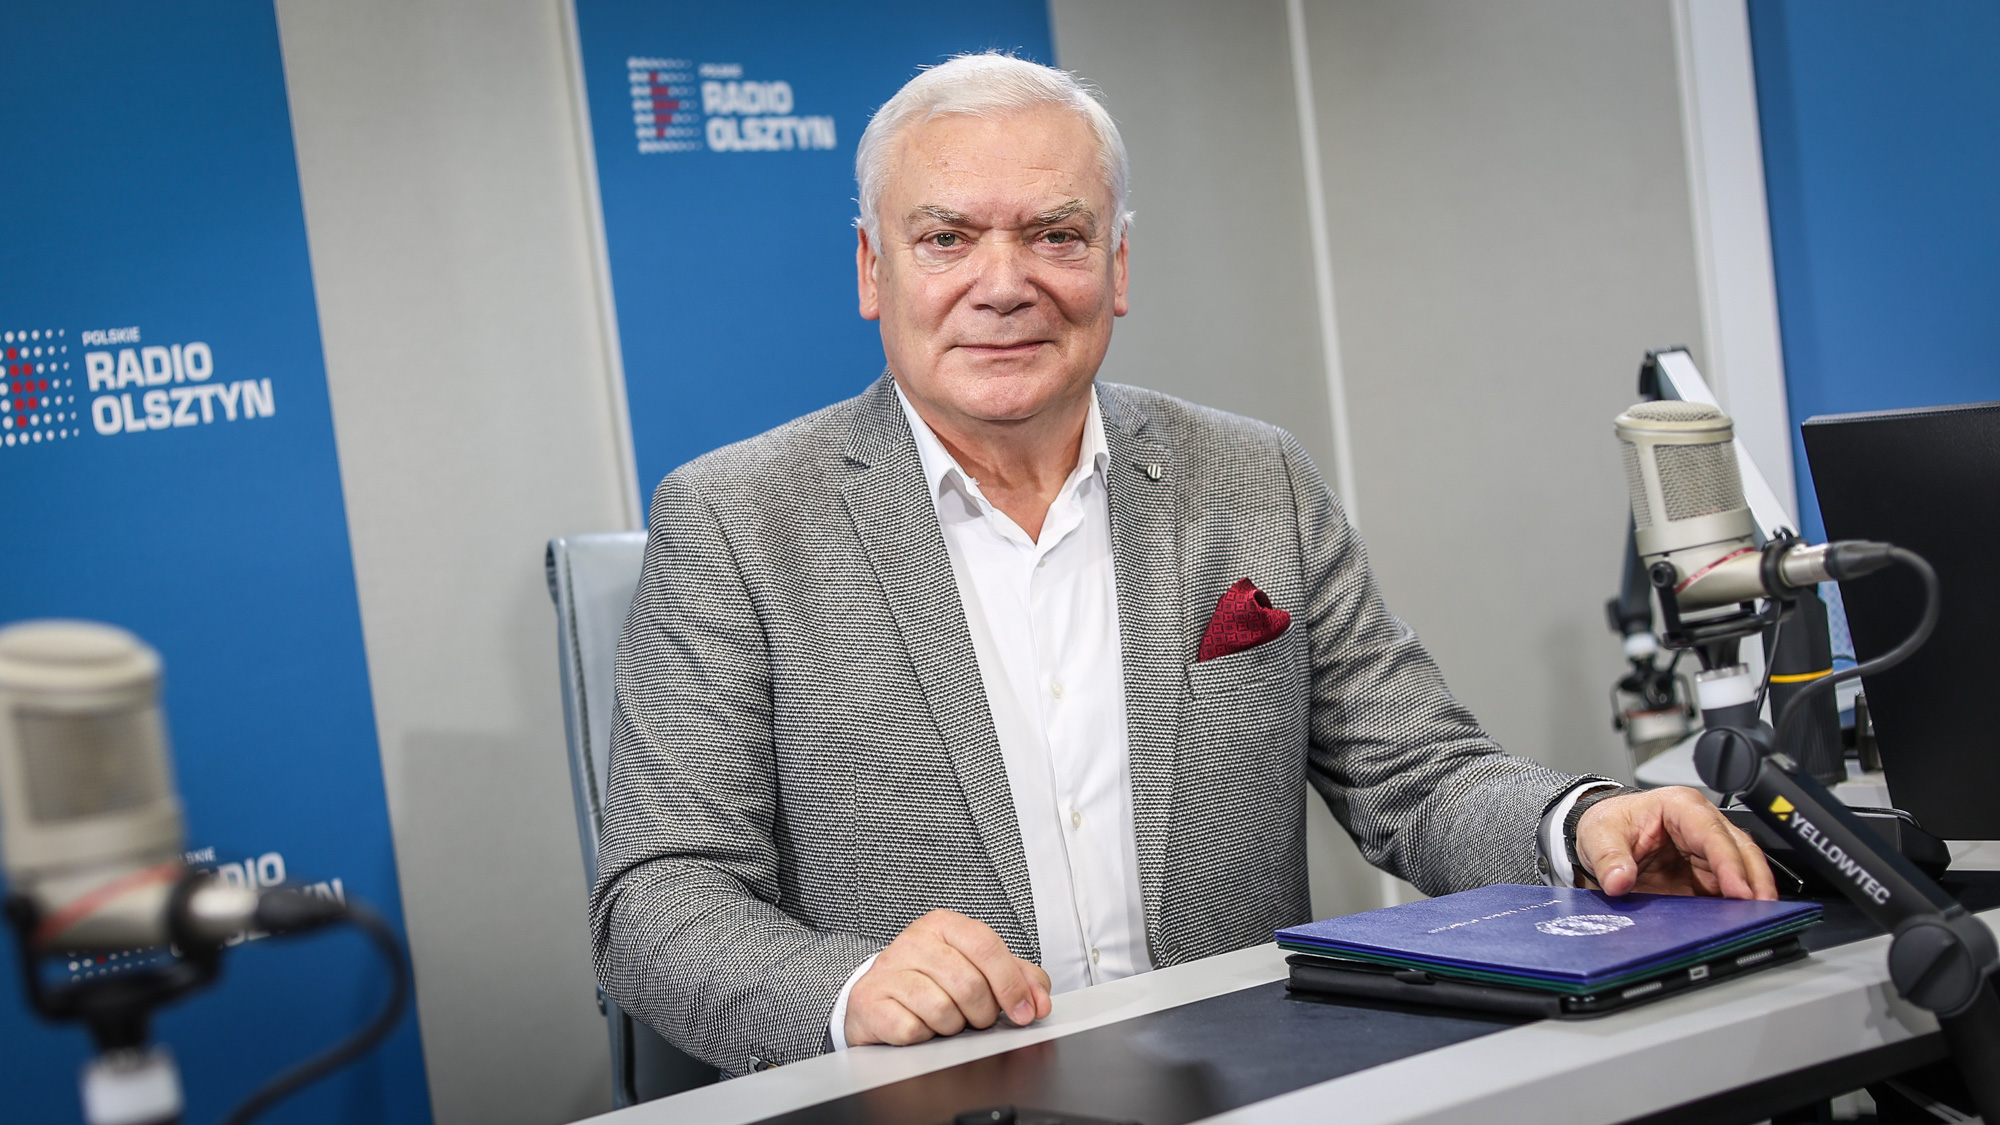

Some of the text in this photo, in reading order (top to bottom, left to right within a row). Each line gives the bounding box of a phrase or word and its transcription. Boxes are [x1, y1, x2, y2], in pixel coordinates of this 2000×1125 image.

[702, 80, 793, 115] RADIO
[706, 116, 836, 151] OLSZTYN
[82, 326, 140, 346] POLSKIE
[85, 342, 213, 391] RADIO
[92, 378, 275, 435] OLSZTYN
[207, 852, 286, 889] DIO
[1790, 812, 1891, 904] YELLOWTEC
